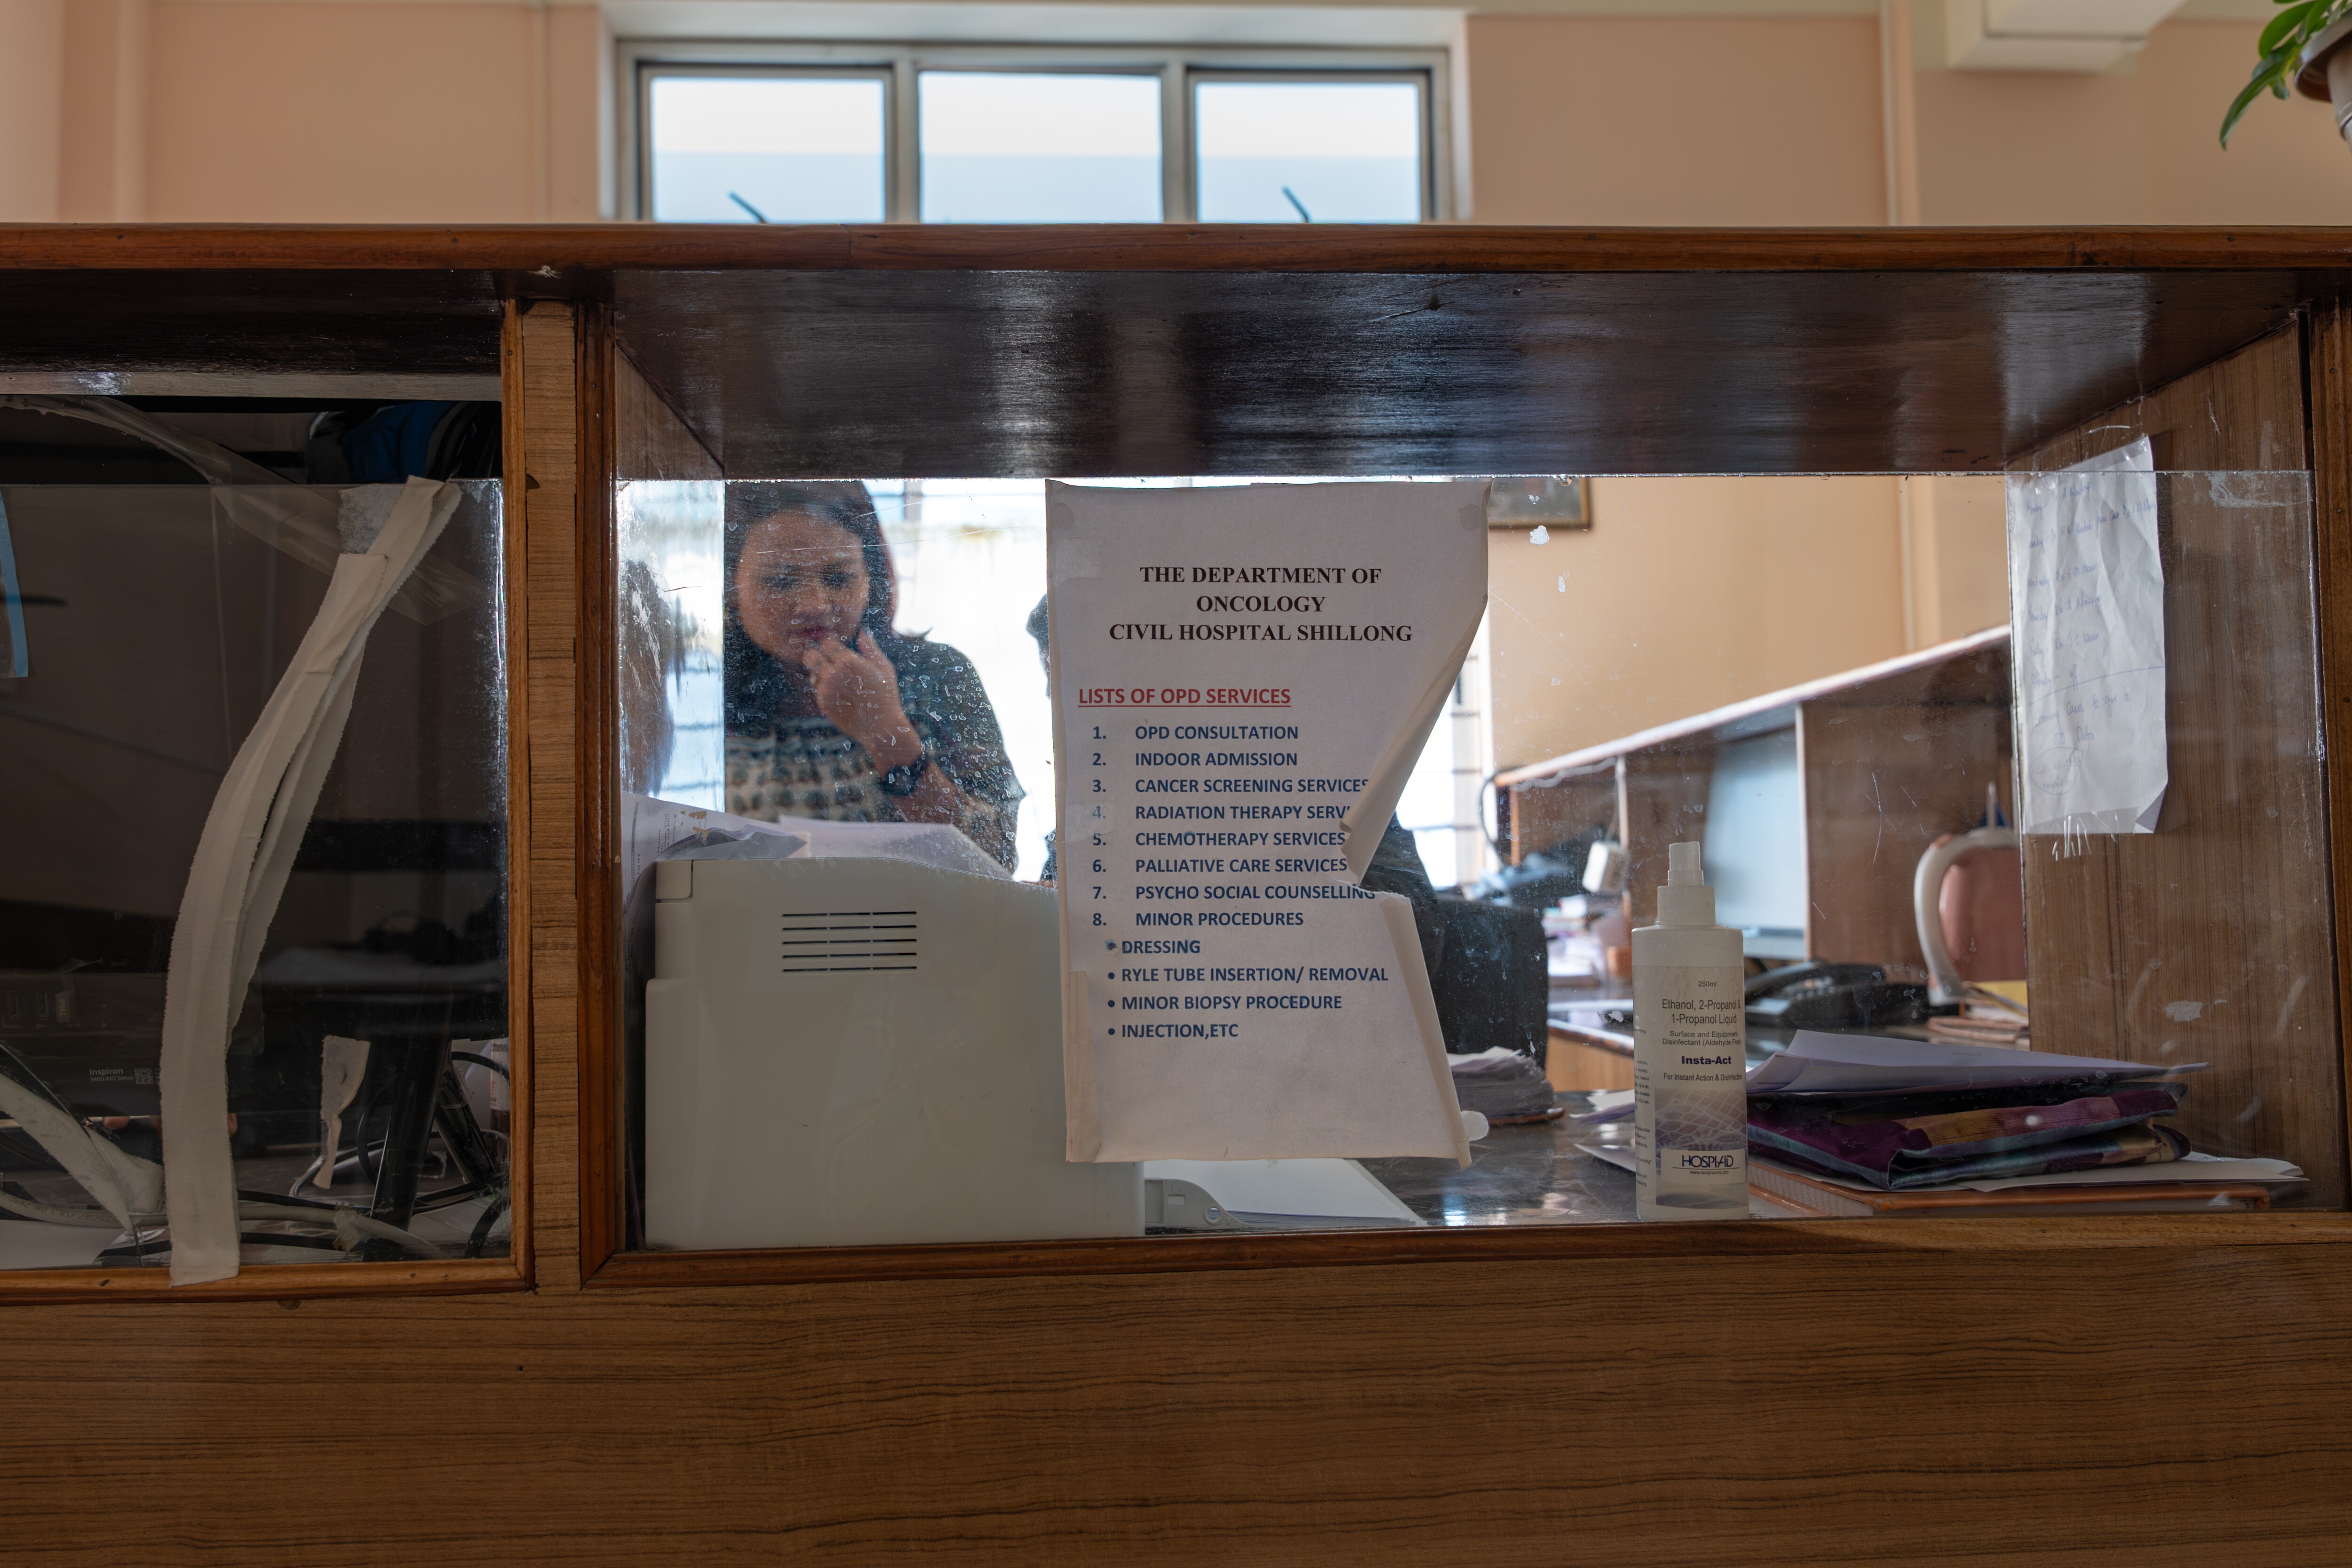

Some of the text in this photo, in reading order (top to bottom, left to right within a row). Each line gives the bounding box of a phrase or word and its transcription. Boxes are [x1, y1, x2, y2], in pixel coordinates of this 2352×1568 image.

[1140, 567, 1381, 583] THE DEPARTMENT OF
[1197, 596, 1326, 612] ONCOLOGY
[1110, 624, 1412, 641] CIVIL HOSPITAL SHILLONG
[1080, 689, 1290, 703] LISTS OF OPD SERVICES
[2123, 686, 2130, 702] to
[1094, 726, 1298, 739] 1. OPD CONSULTATION
[1093, 753, 1297, 765] 2. INDOOR ADMISSION
[1093, 780, 1106, 792] 3.
[1136, 780, 1199, 792] CANCER
[1204, 780, 1292, 792] SCREENING
[1092, 806, 1105, 819] 4.
[1136, 806, 1224, 819] RADIATION
[1230, 806, 1302, 819] THERAPY
[1093, 831, 1345, 845] 5. CHEMOTHERAPY SERVICES
[1093, 859, 1347, 872] 6. PALLIATIVE CARE SERVICES
[1093, 886, 1106, 899] 7.
[1136, 886, 1199, 899] PSYCHO
[1204, 886, 1260, 899] SOCIAL
[1093, 913, 1303, 926] 8. MINOR PROCEDURES
[1122, 940, 1200, 954] DRESSING
[1122, 967, 1388, 983] RYLE TUBE INSERTION/ REMOVAL
[1122, 996, 1342, 1009] MINOR BIOPSY PROCEDURE
[1662, 999, 1741, 1012] Ethanol, 2-Propanol &
[1671, 1014, 1737, 1026] 1-Propanol Liquid
[1122, 1024, 1238, 1039] INJECTION,ETC
[1711, 1031, 1738, 1039] Equipment
[1681, 1055, 1732, 1065] Insta-Act
[89, 1067, 124, 1076] Inspiron
